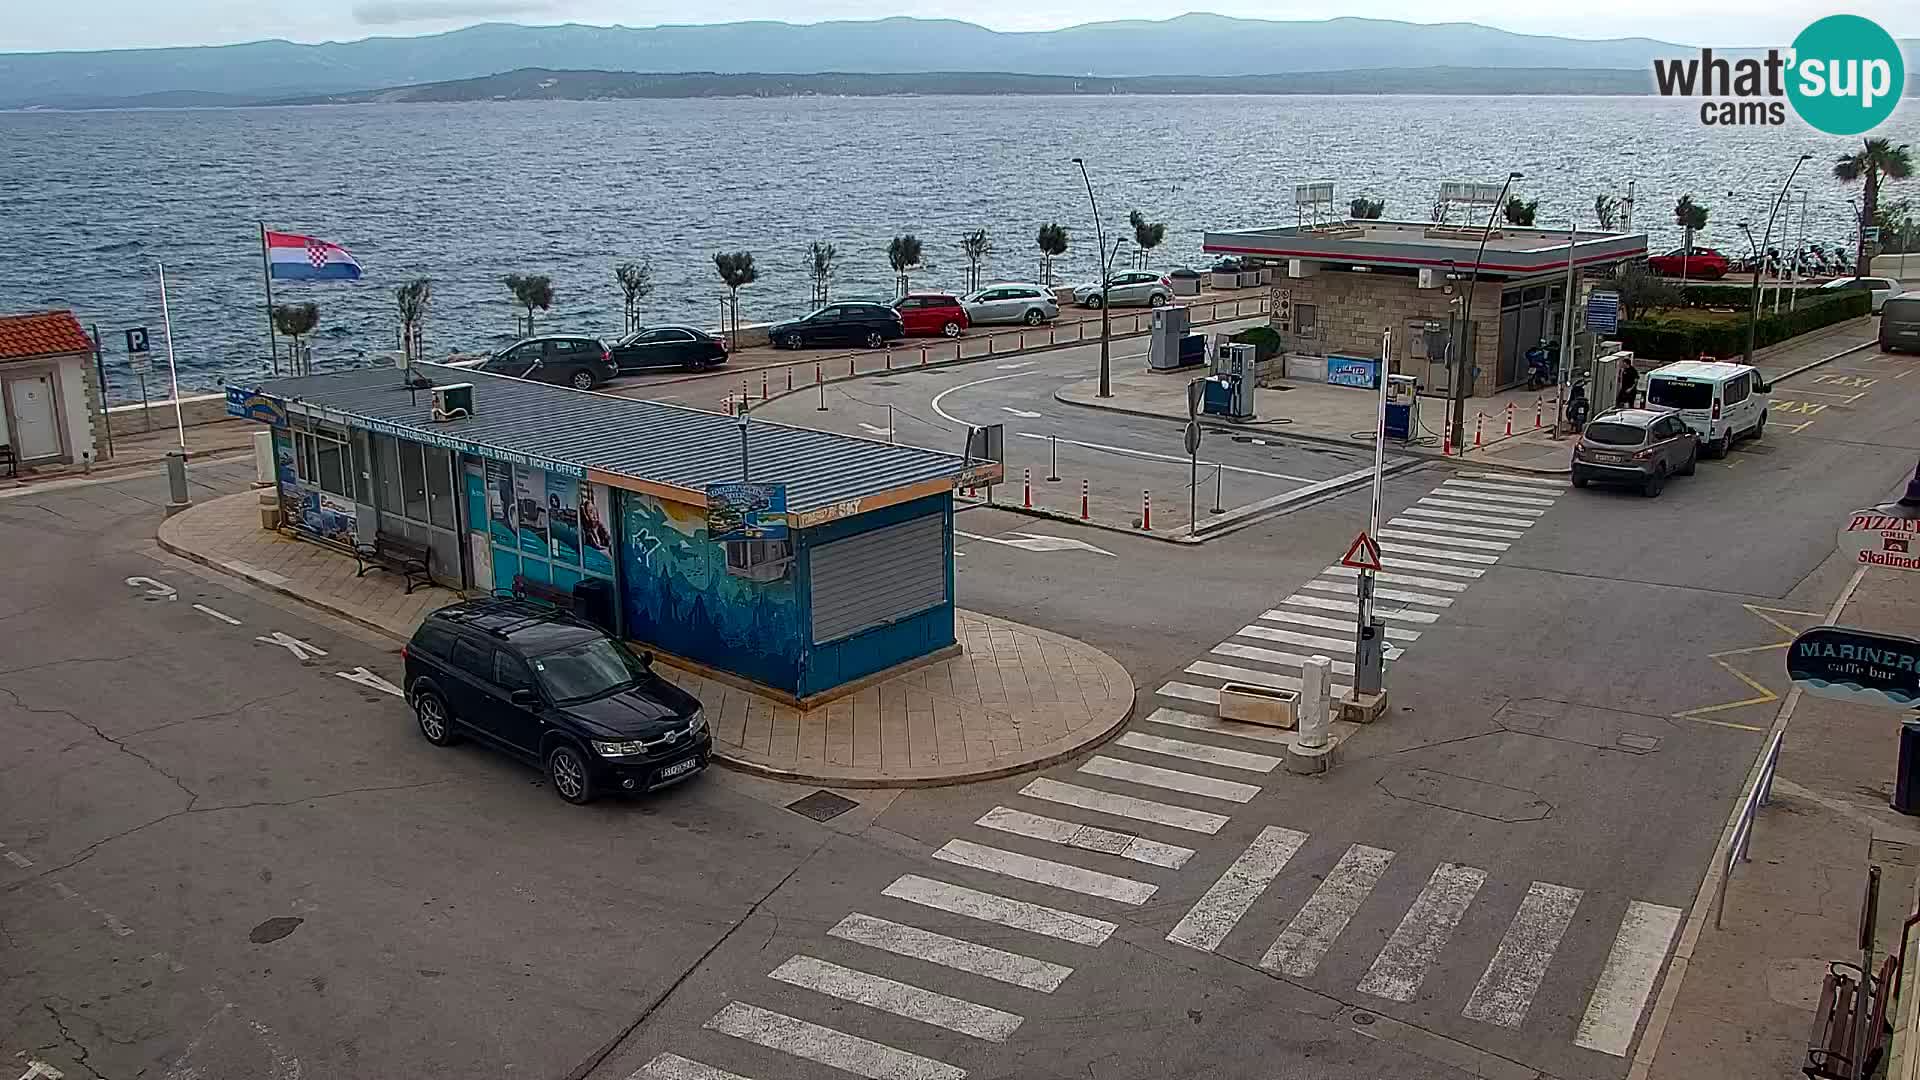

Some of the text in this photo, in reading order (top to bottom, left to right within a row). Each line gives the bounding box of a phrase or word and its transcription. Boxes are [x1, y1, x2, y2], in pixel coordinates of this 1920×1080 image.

[132, 331, 144, 350] P
[1812, 375, 1879, 388] TAXI
[437, 438, 468, 451] POSTAJA
[479, 447, 494, 458] BUS
[495, 450, 526, 465] STATION
[529, 457, 554, 470] TICKET
[556, 462, 583, 477] OFFICE
[1880, 530, 1916, 541] GRILL
[1827, 662, 1896, 680] caffe bar
